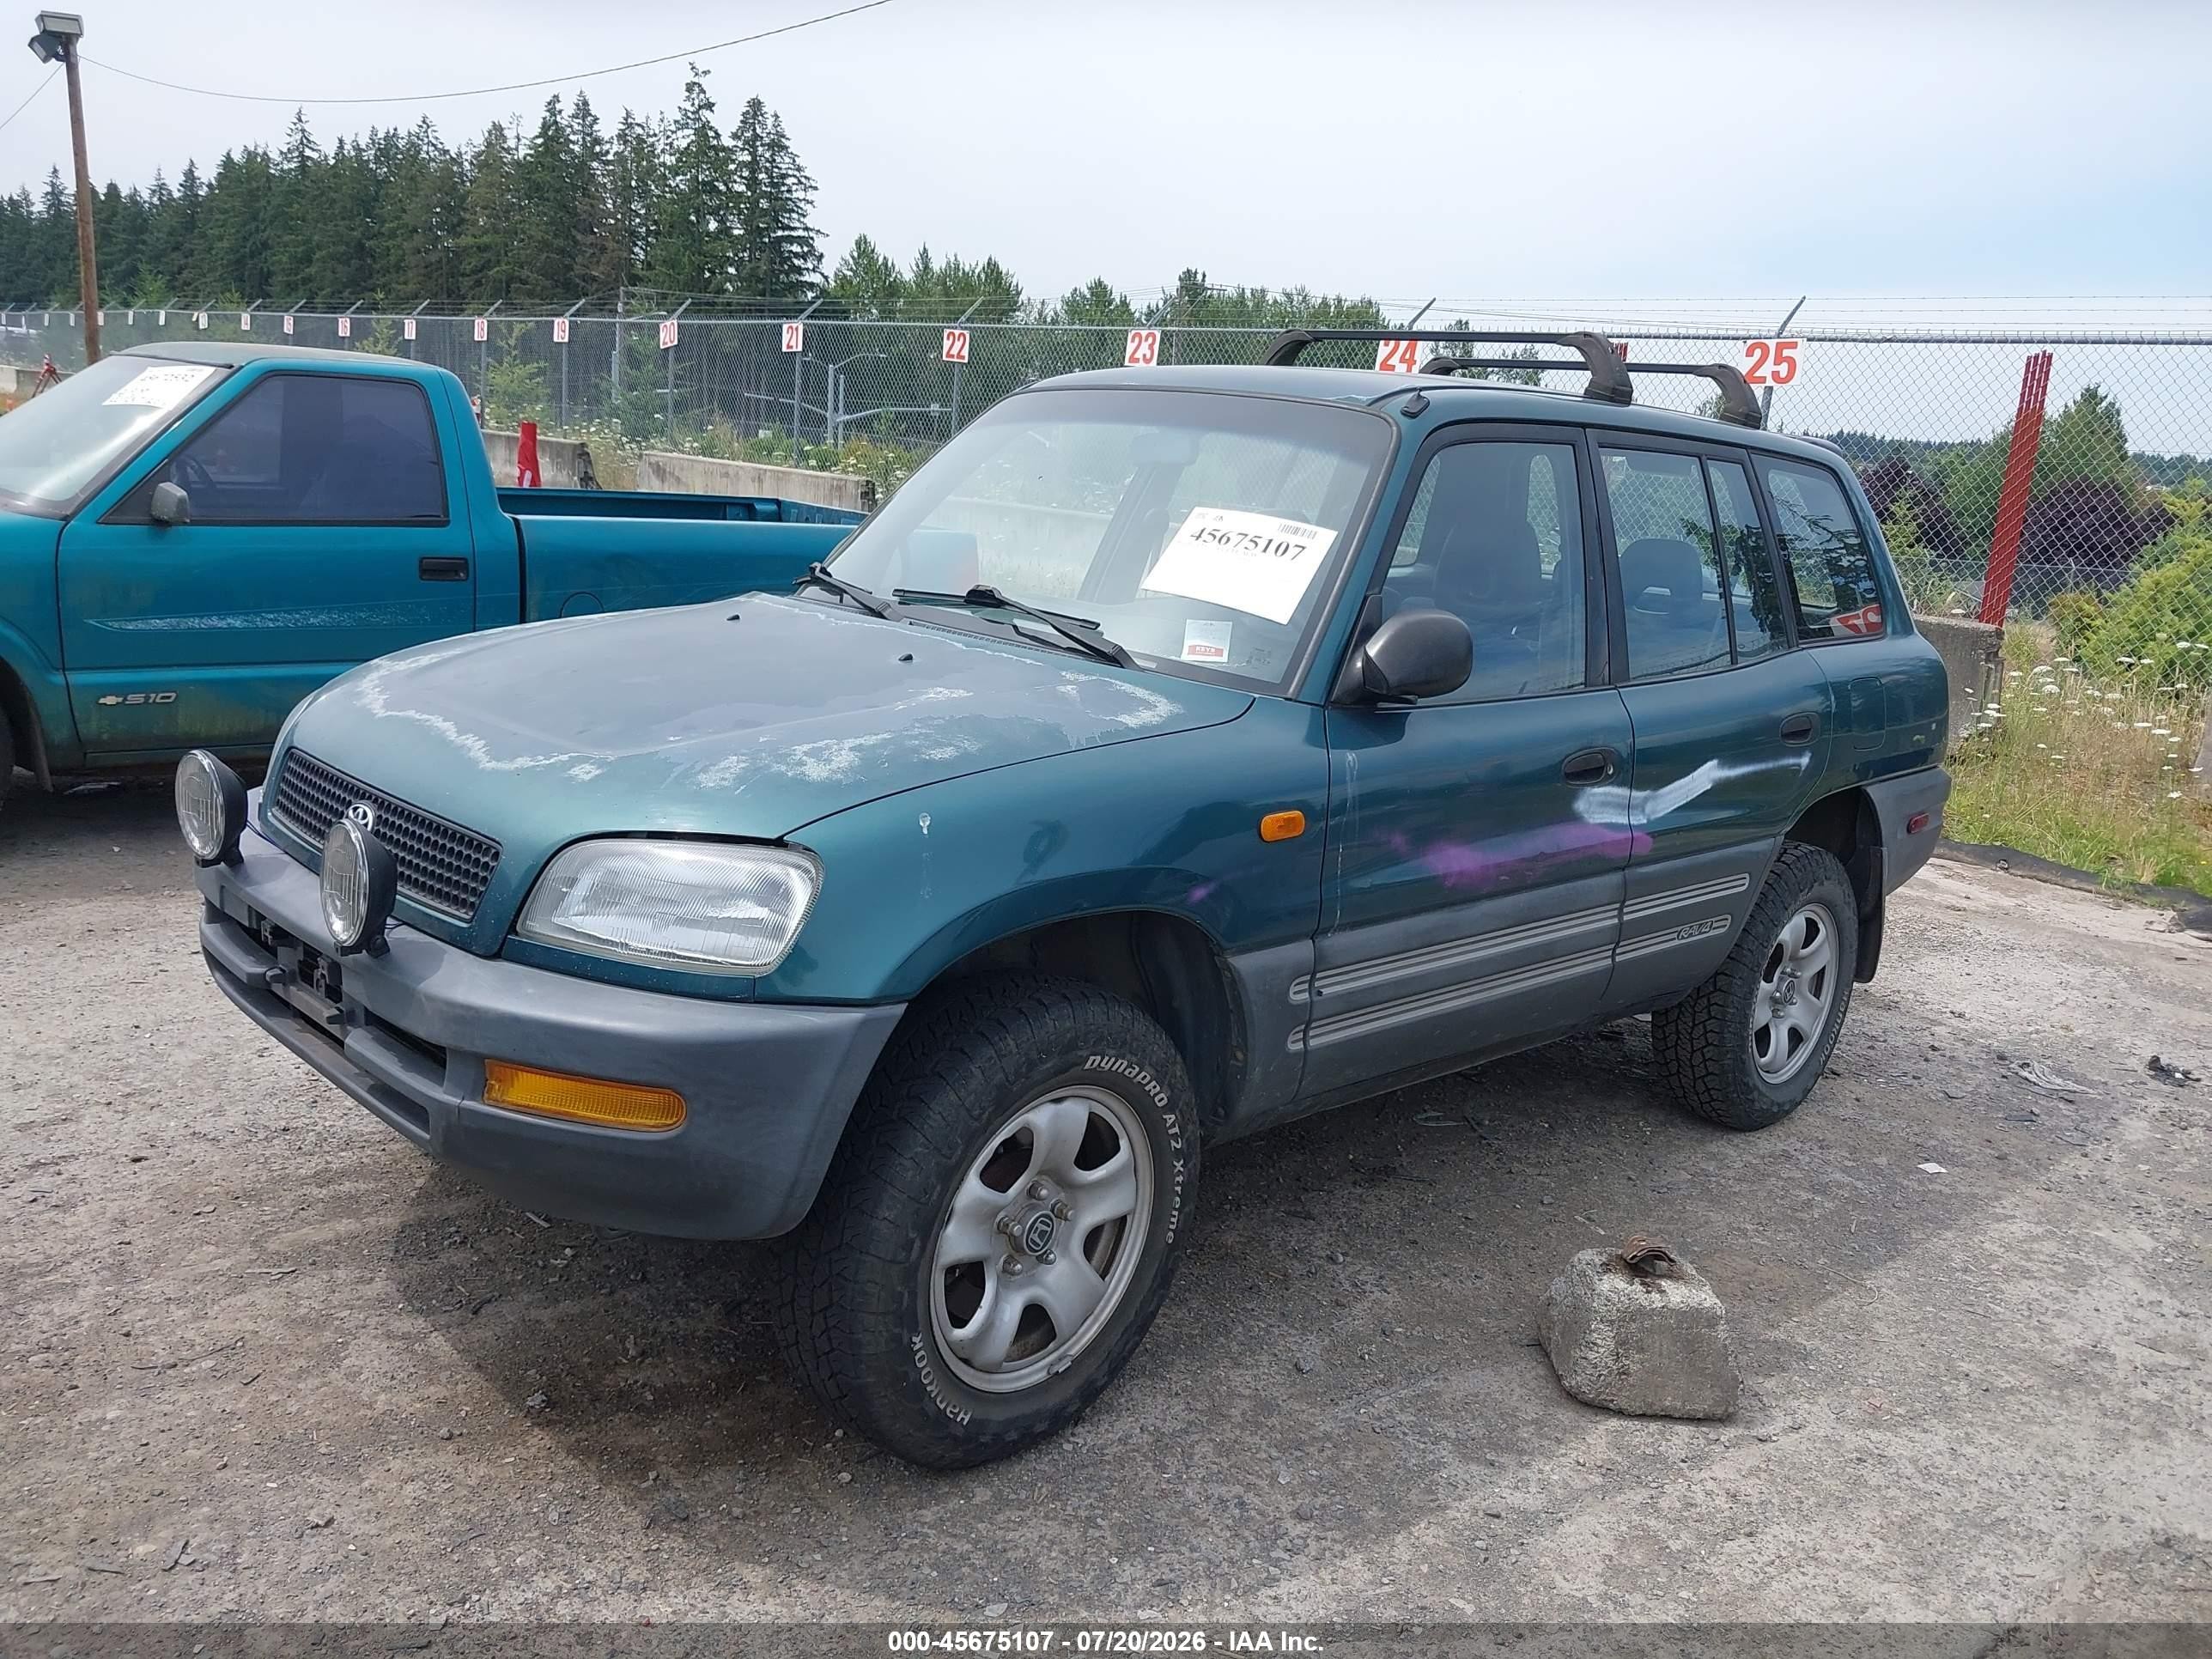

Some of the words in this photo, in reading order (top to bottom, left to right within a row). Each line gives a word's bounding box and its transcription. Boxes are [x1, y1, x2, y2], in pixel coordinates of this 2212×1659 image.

[477, 320, 485, 338] 18
[556, 320, 567, 340] 19
[661, 321, 676, 346] 20
[786, 325, 799, 349] 21
[945, 331, 967, 360] 22
[1127, 331, 1157, 364] 23
[1378, 339, 1418, 373] 24
[1744, 341, 1798, 384] 25
[1189, 526, 1307, 561] 45675107
[124, 692, 178, 704] S10
[1678, 921, 1712, 940] RAV4
[1162, 1113, 1182, 1152] AT2
